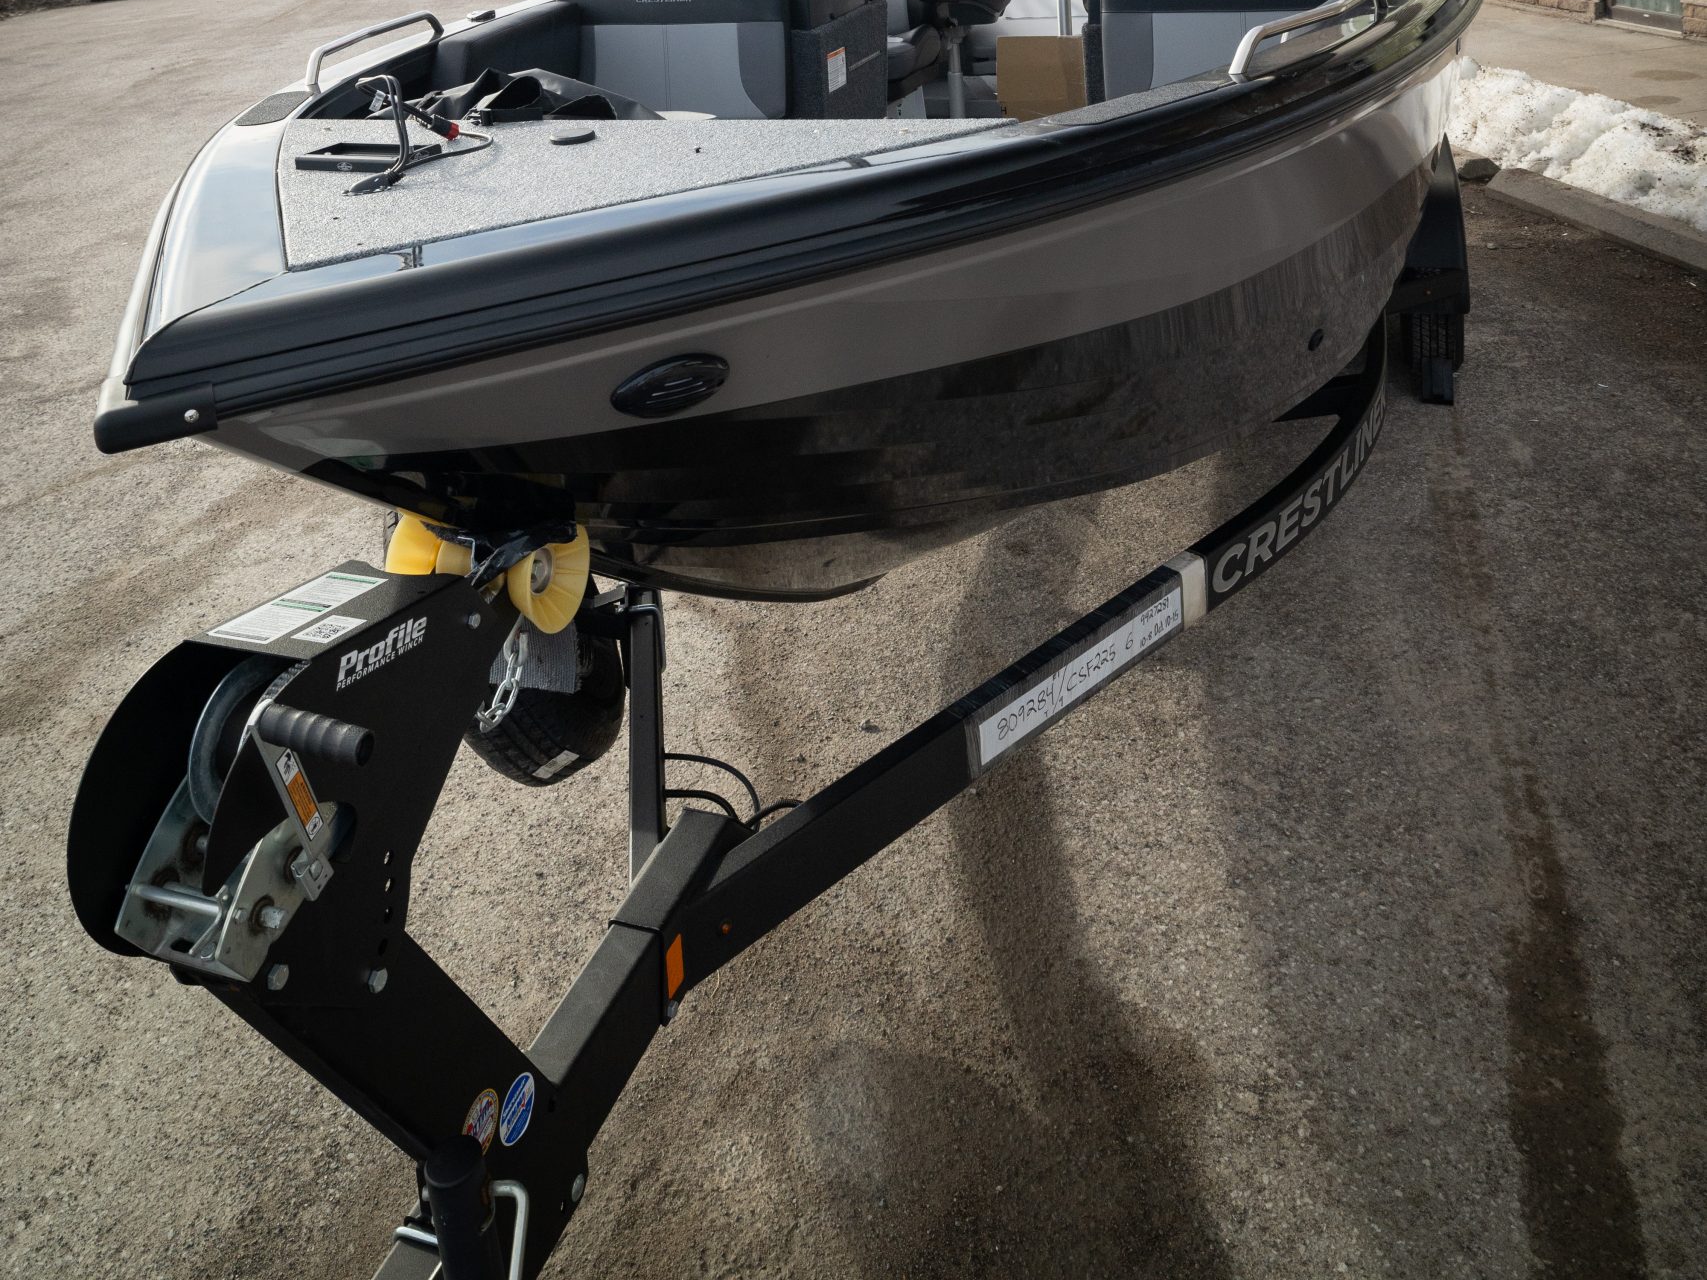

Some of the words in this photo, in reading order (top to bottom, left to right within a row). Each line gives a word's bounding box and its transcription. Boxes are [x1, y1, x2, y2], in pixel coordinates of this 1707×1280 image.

[1212, 382, 1386, 593] CRESTLINER
[336, 651, 396, 692] PERFORMANCE
[398, 634, 424, 656] WINCH
[337, 616, 428, 683] Profile
